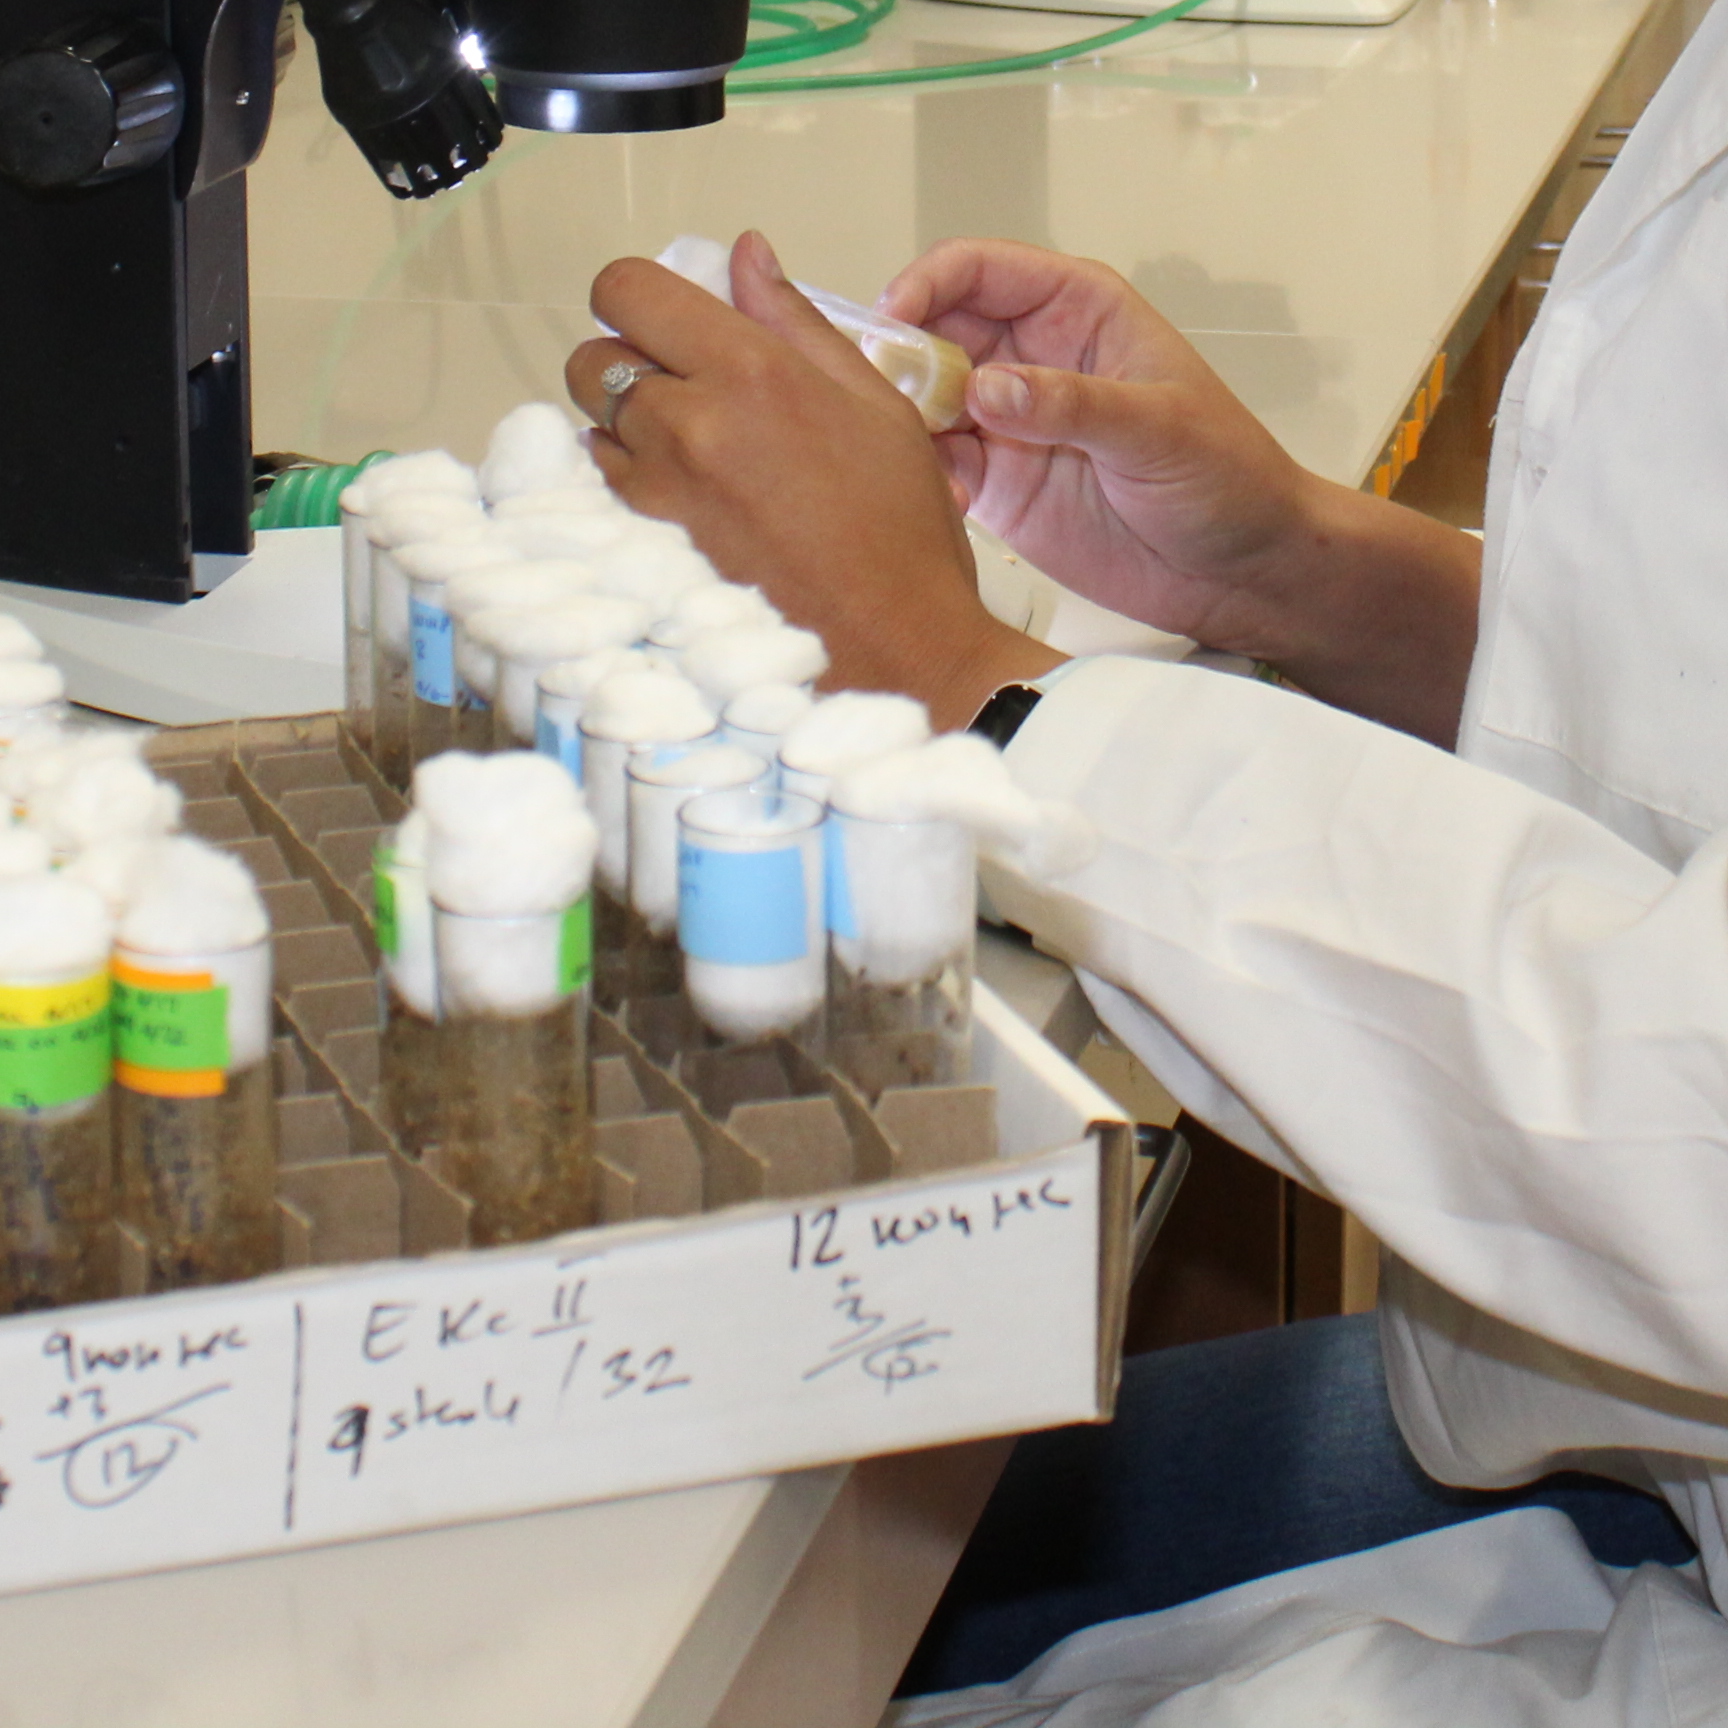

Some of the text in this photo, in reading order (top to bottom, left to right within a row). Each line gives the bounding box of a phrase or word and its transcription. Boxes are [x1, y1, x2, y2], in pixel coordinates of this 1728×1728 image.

[790, 1204, 845, 1271] 12
[362, 1302, 416, 1363] E
[601, 1346, 692, 1400] 32
